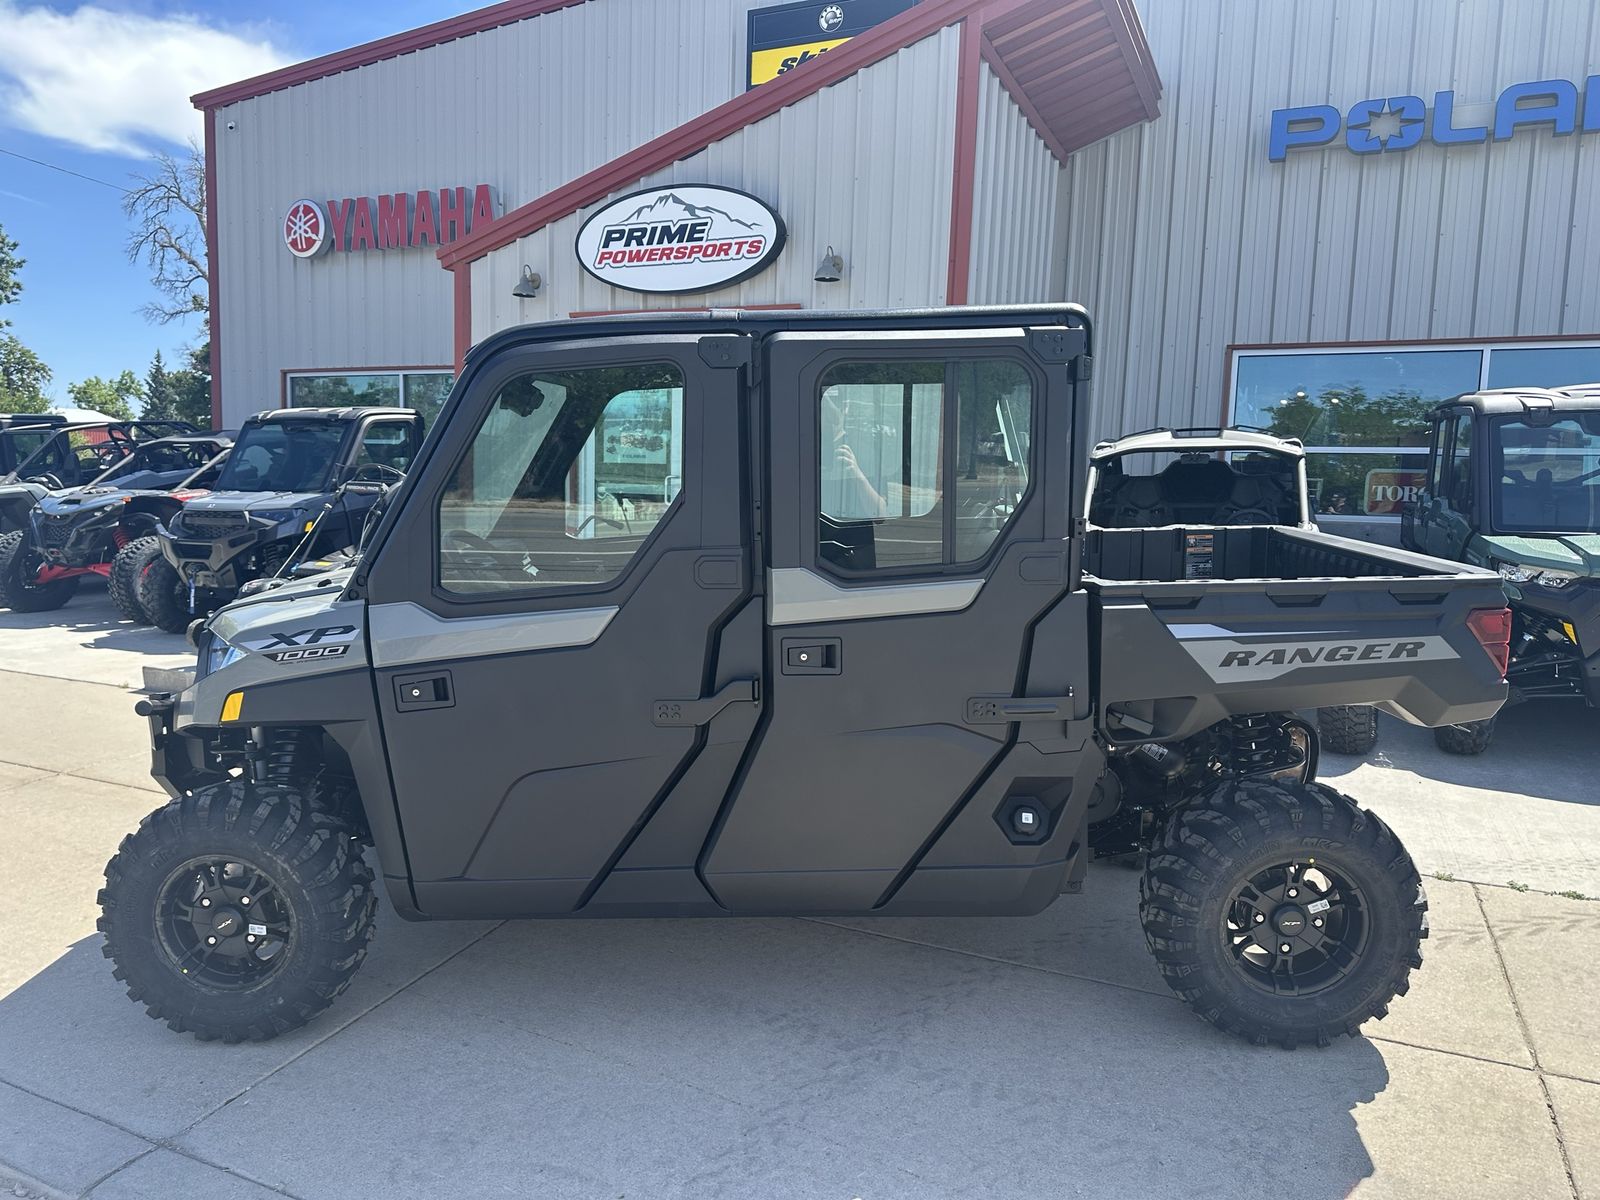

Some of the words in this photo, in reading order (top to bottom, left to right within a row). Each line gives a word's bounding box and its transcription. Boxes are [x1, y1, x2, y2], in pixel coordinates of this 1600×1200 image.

[777, 48, 828, 75] sk
[1269, 75, 1600, 163] POLA
[327, 184, 495, 253] YAMAHA
[602, 221, 708, 249] PRIME
[597, 239, 763, 265] POWERSPORTS
[1372, 485, 1426, 502] TOR
[257, 624, 357, 650] XP
[275, 646, 345, 662] 1000
[1218, 641, 1426, 668] RANGER
